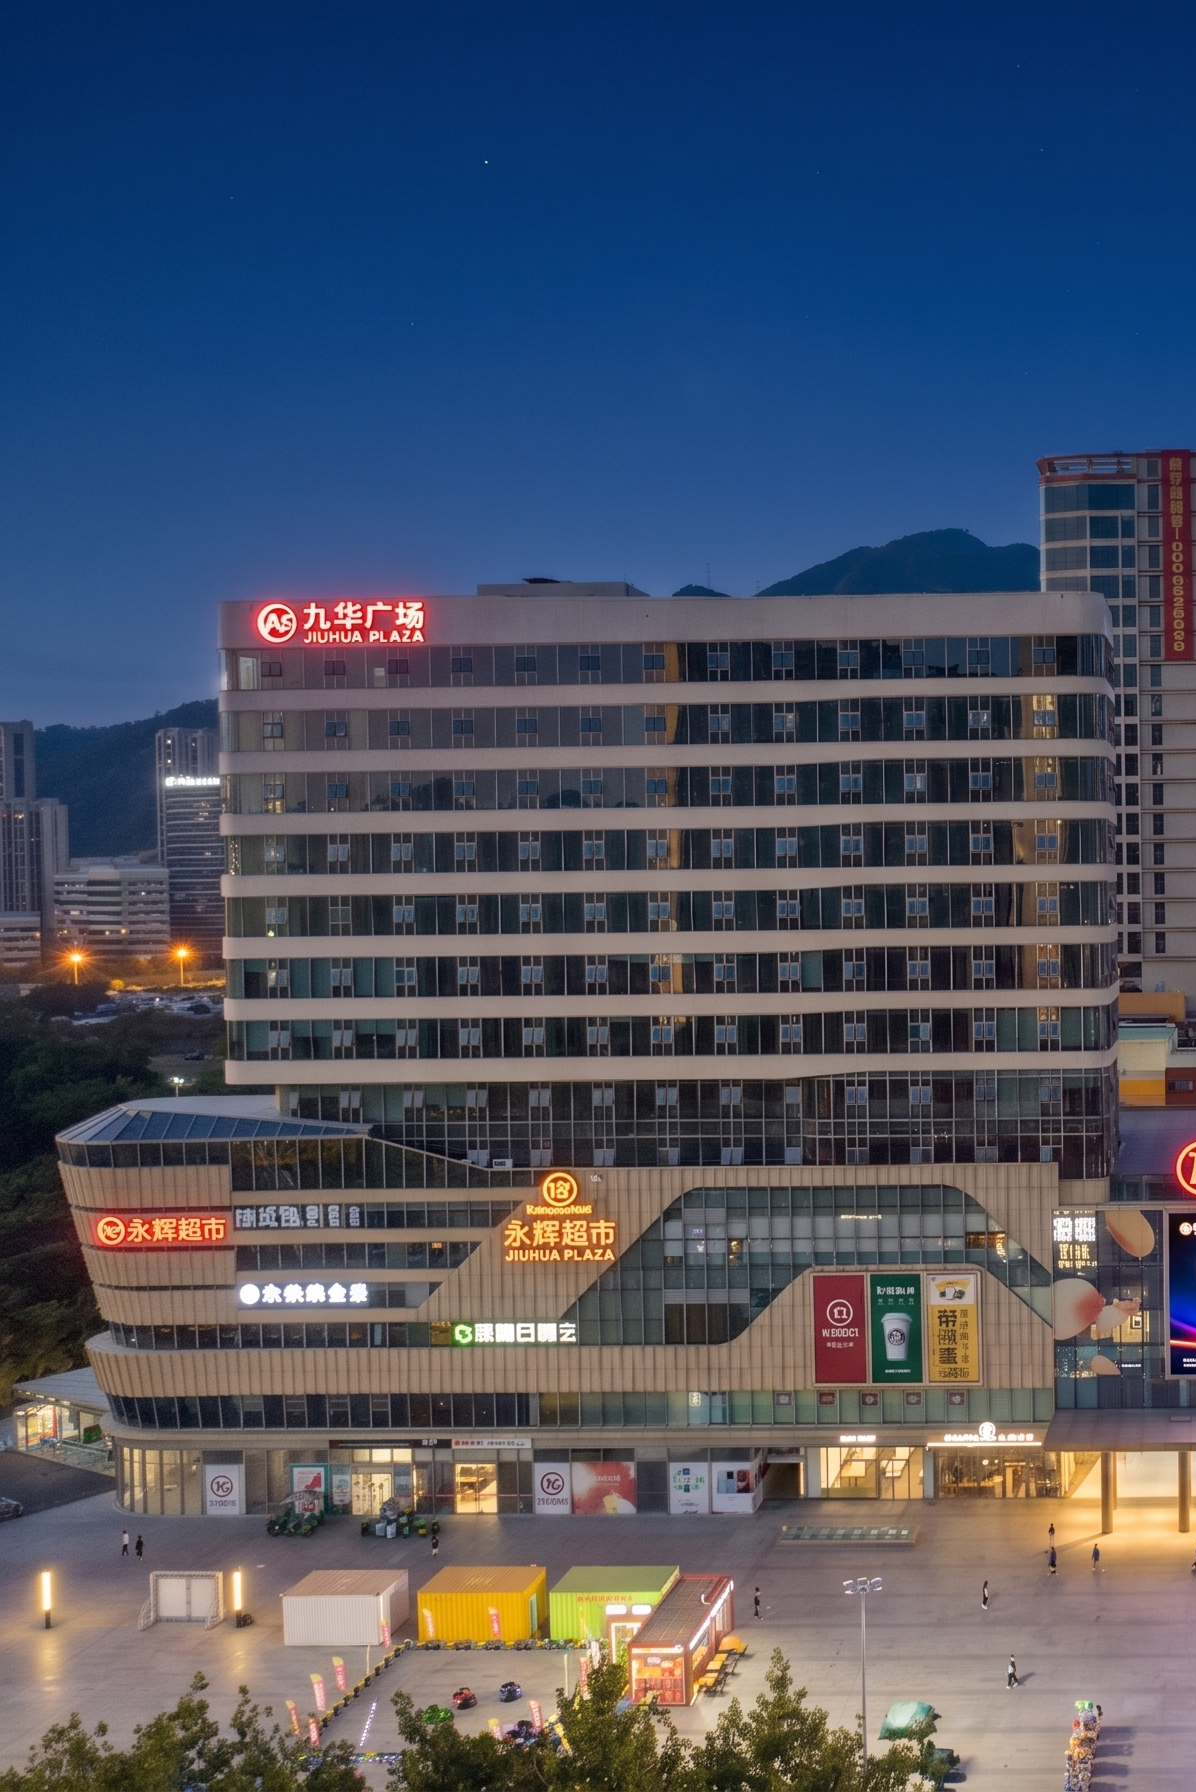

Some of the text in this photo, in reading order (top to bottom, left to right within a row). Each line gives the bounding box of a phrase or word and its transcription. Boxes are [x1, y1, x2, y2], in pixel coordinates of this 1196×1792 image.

[303, 601, 424, 630] 九华广场
[303, 629, 425, 644] JIUHUA PLAZA
[126, 1217, 226, 1242] 永辉超市
[504, 1219, 616, 1247] 永辉超市
[505, 1248, 616, 1262] JIUHUA PLAZA
